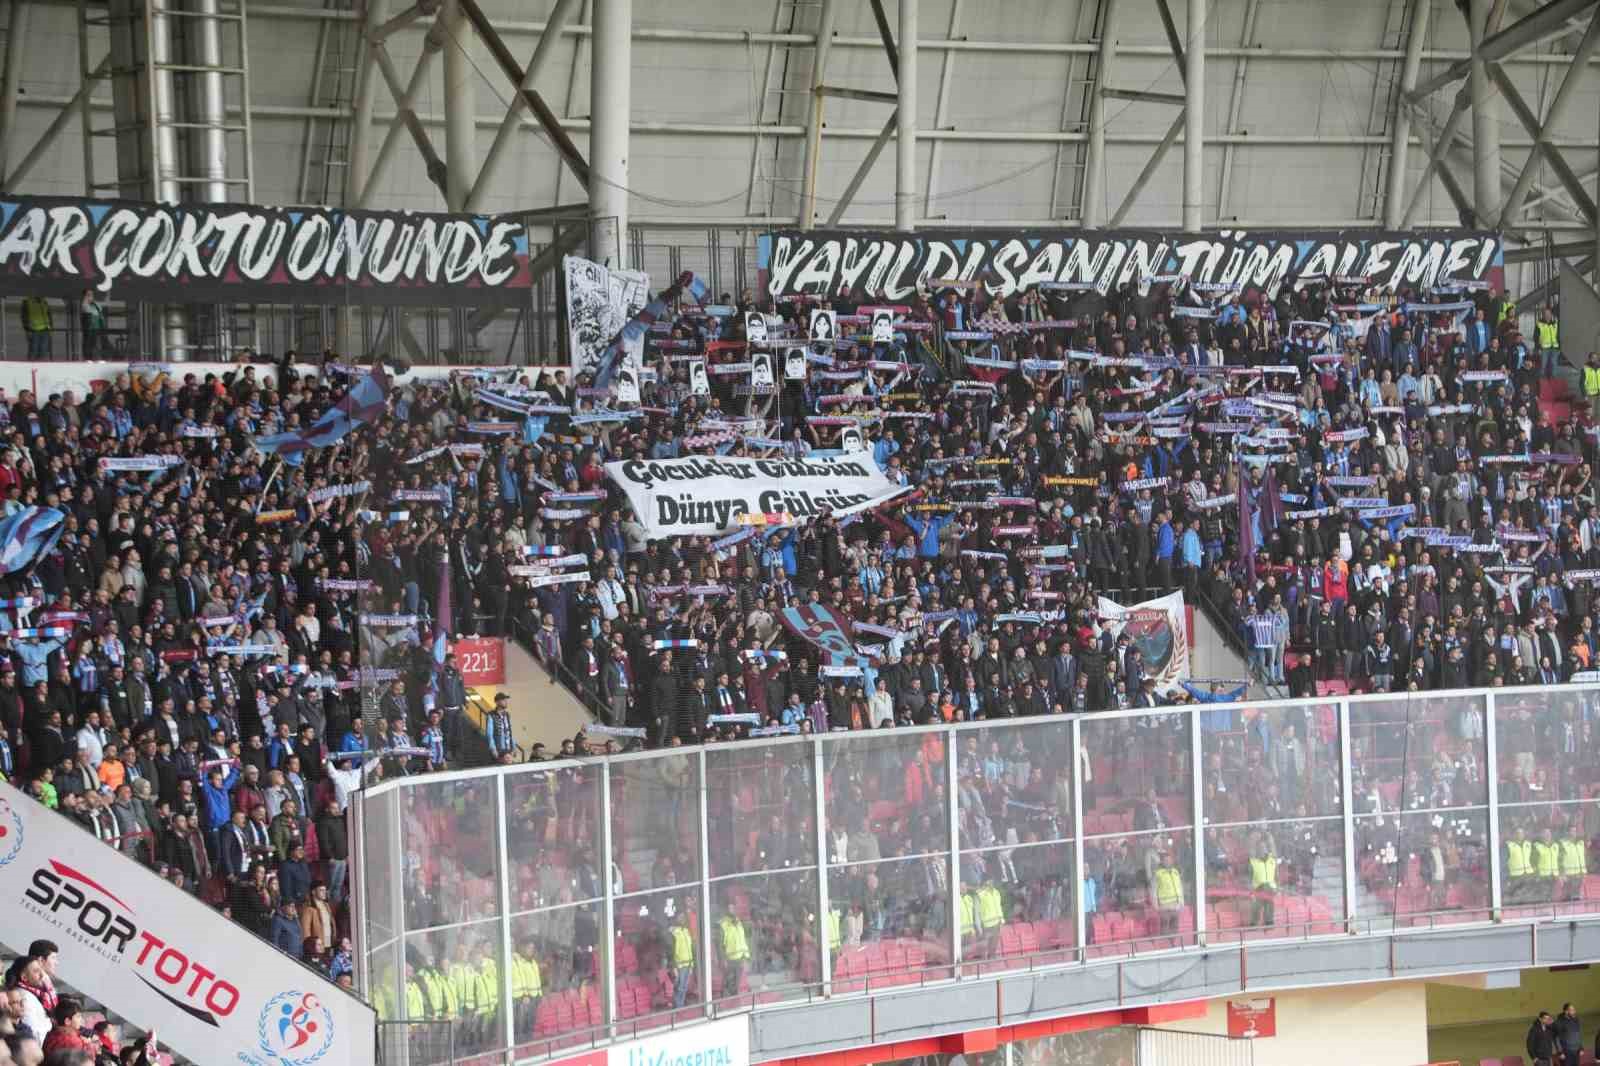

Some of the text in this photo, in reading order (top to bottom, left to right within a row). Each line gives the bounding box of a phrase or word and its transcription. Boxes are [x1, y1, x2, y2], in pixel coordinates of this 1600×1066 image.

[1171, 230, 1293, 301] TÜM
[622, 456, 870, 490] Çocuklar Gülsün
[656, 488, 873, 530] Dünya Gülsün
[462, 651, 490, 673] 221
[25, 868, 240, 1017] SPOR TOTO
